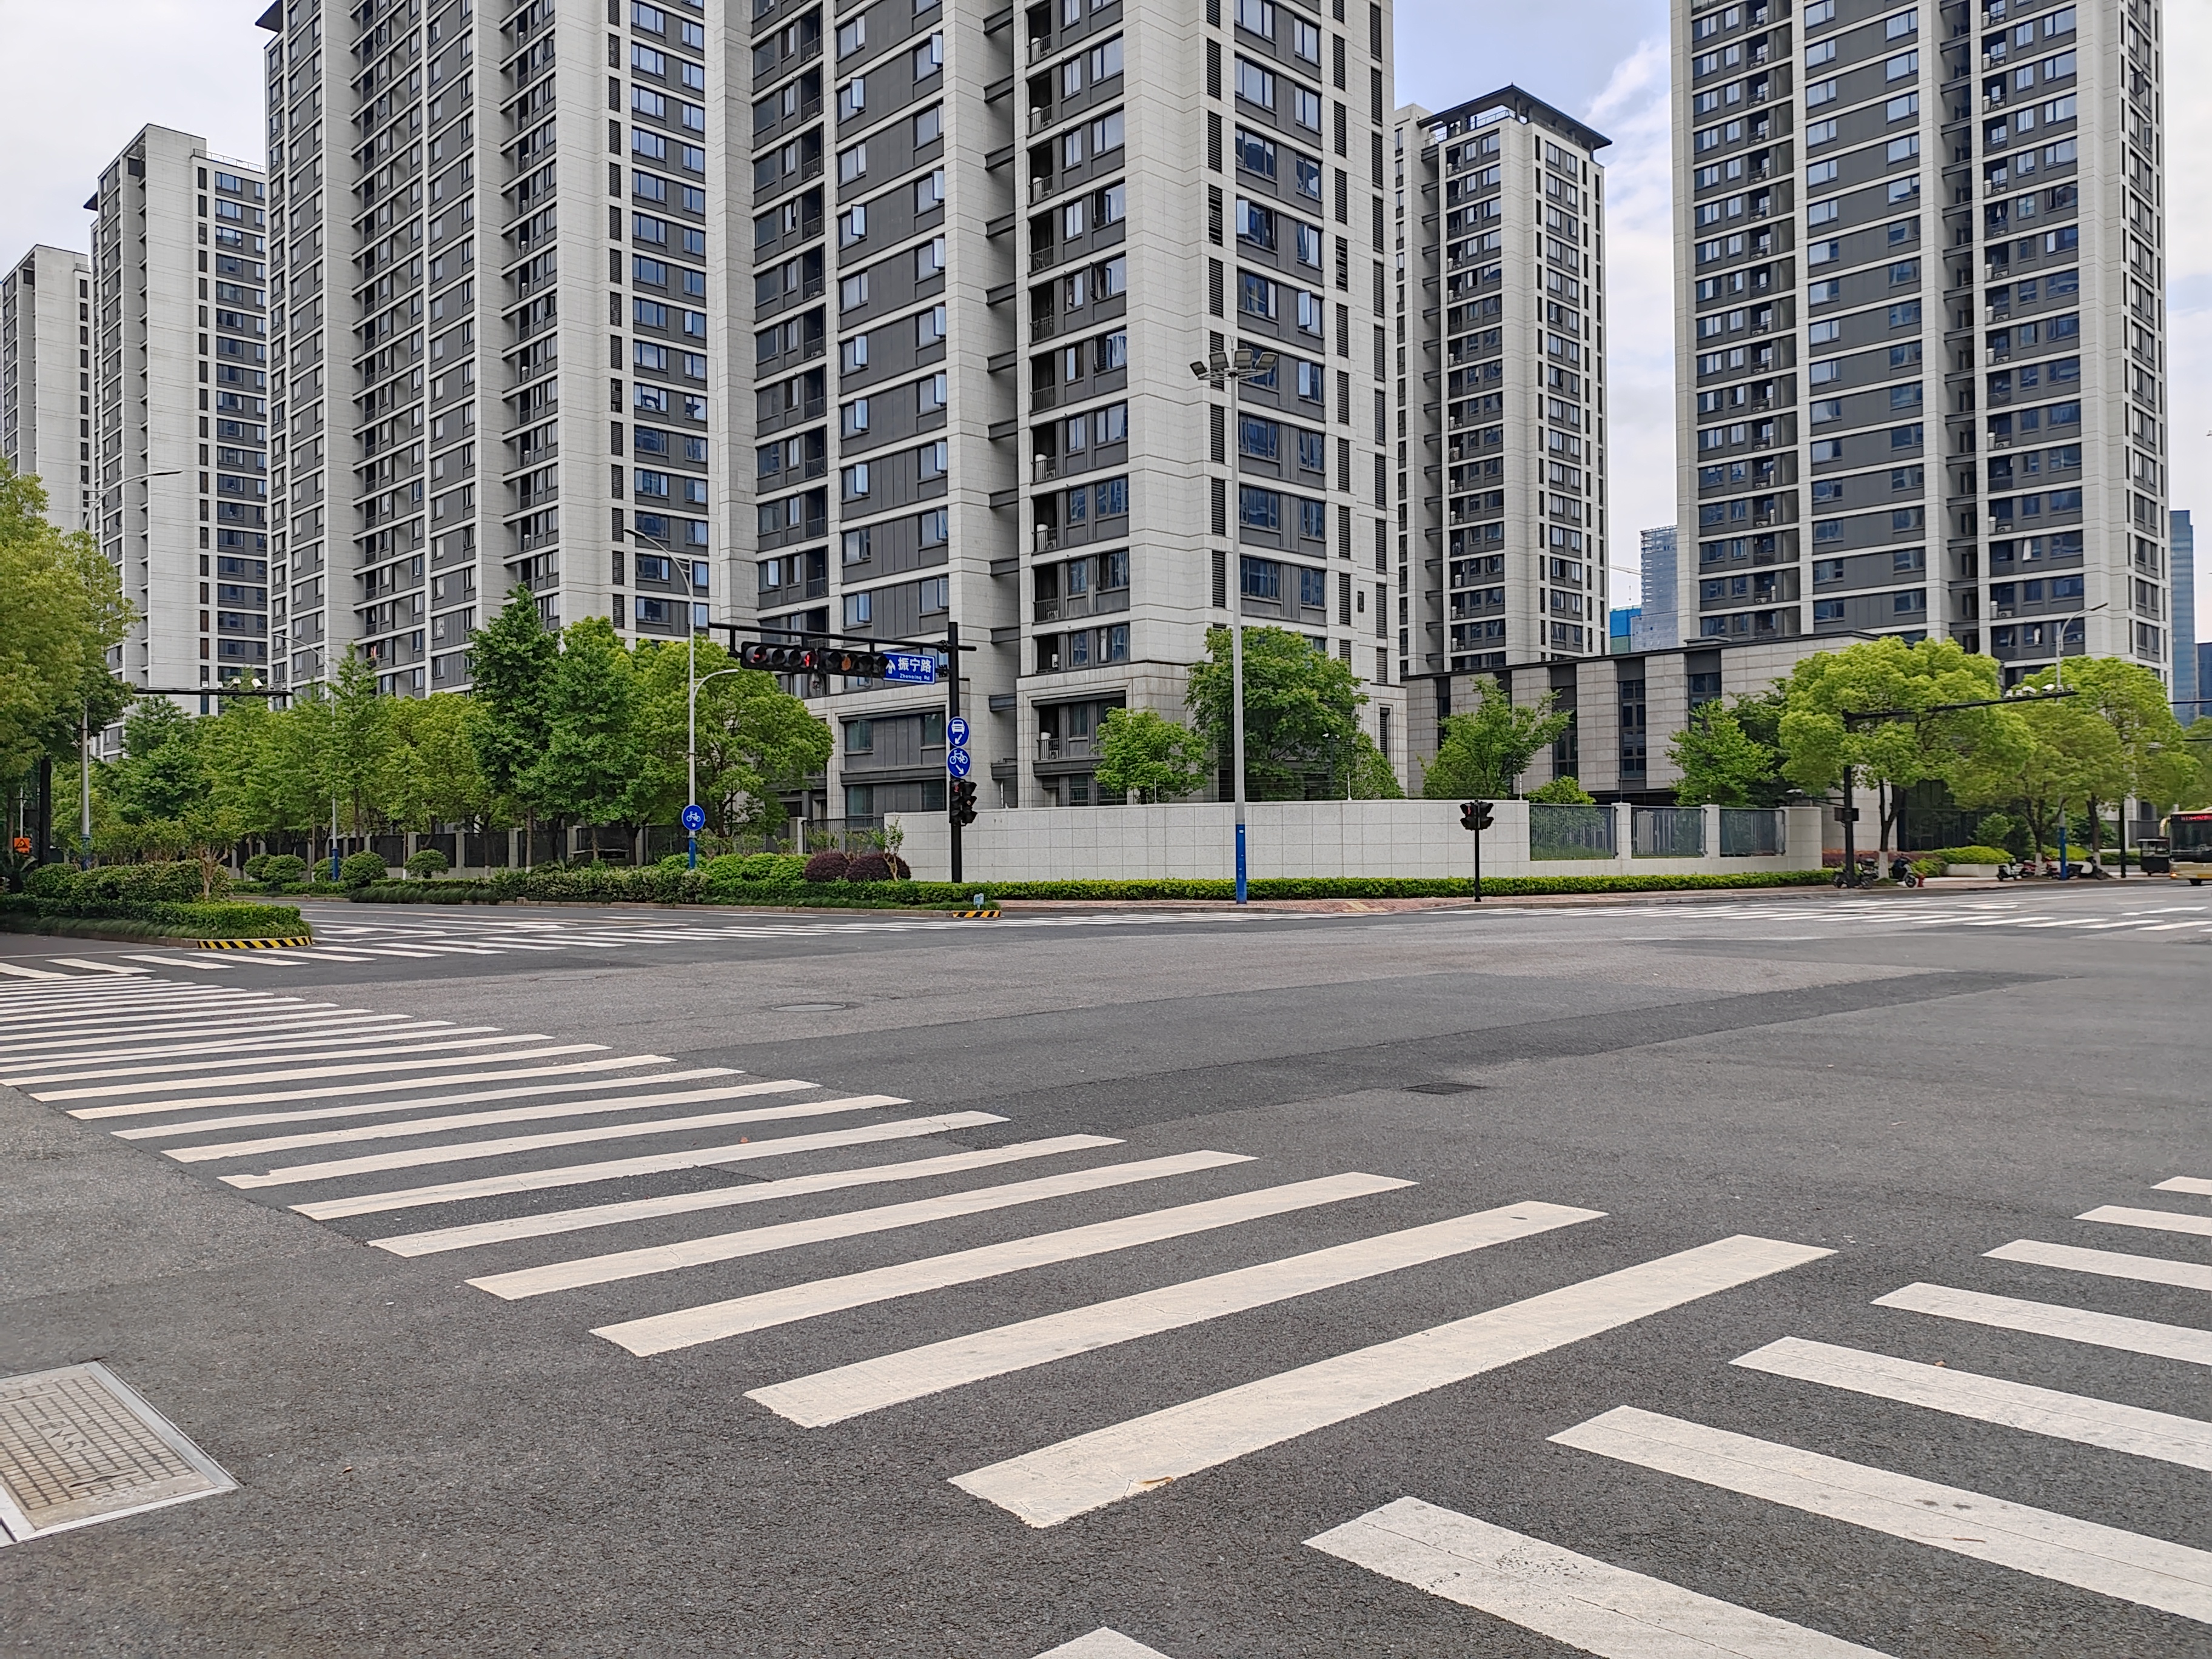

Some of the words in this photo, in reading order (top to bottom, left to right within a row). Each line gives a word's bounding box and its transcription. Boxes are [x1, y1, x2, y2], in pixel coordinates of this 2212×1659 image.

[898, 657, 931, 673] 振宁路
[38, 1420, 88, 1452] 电力
